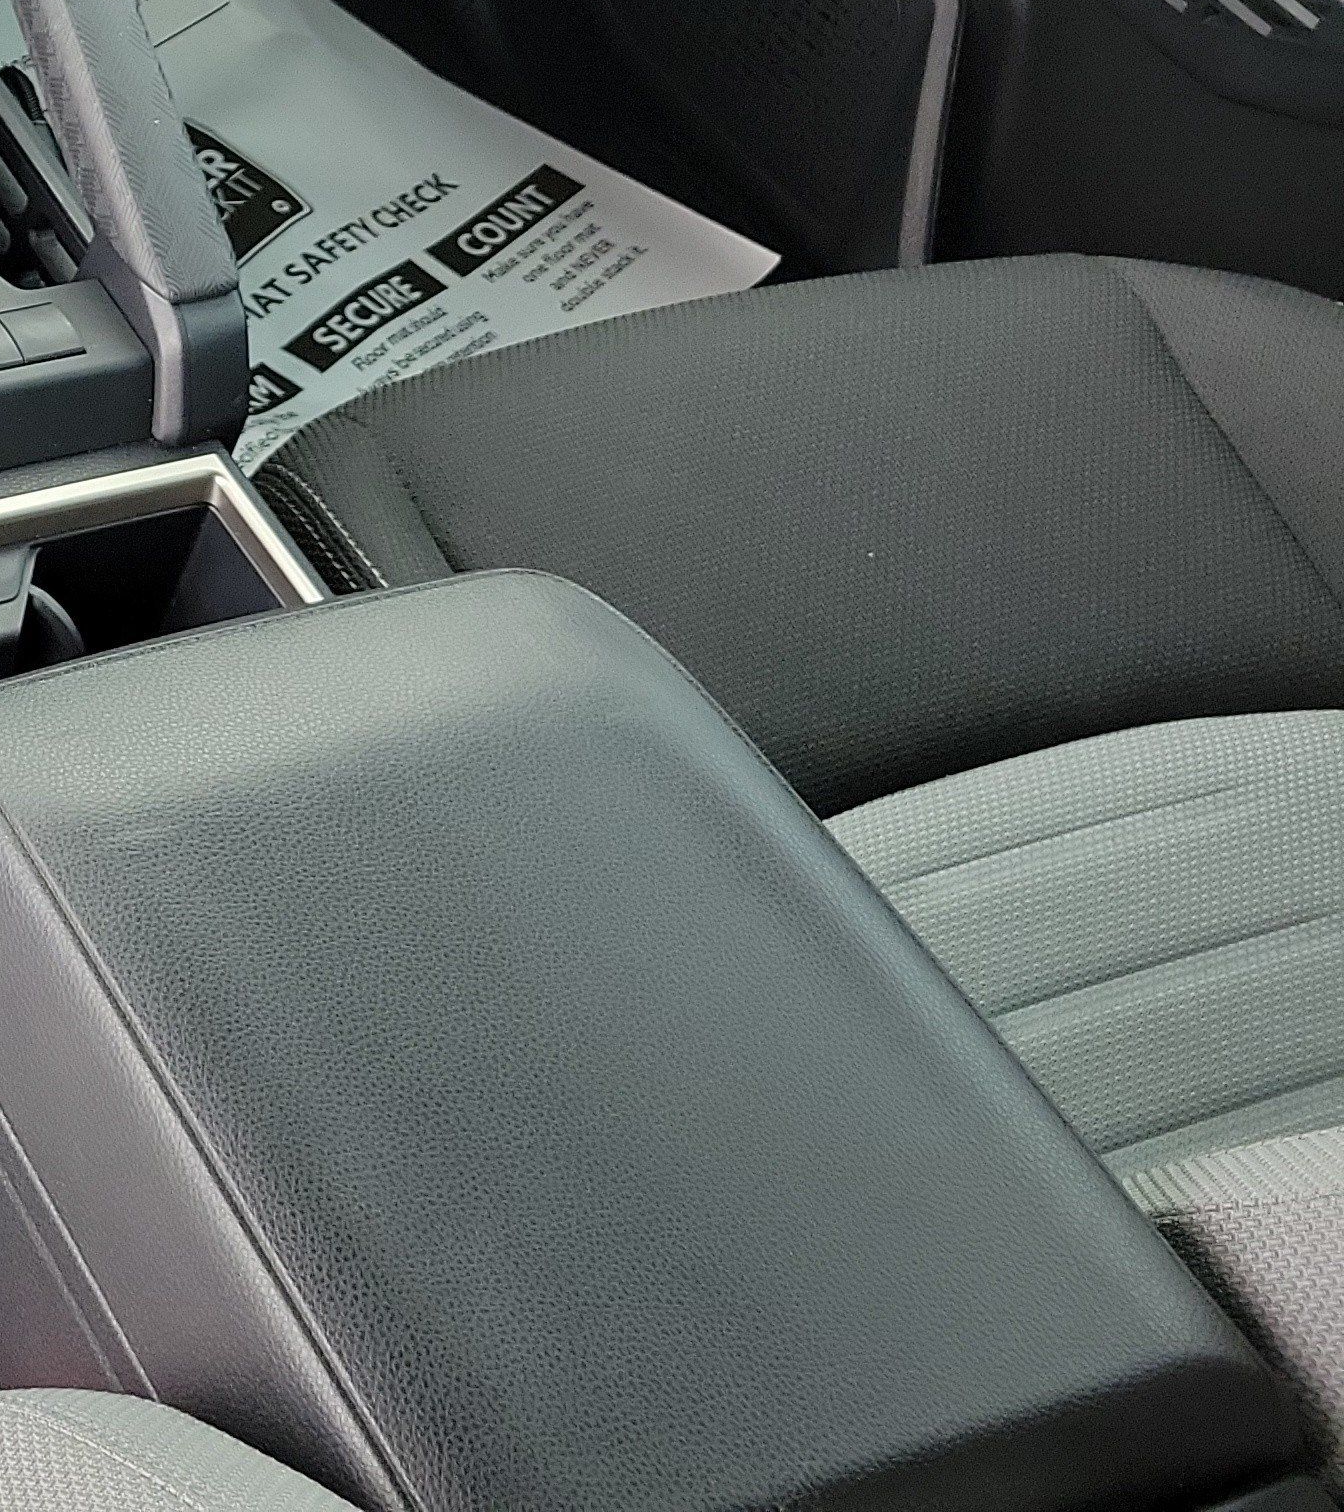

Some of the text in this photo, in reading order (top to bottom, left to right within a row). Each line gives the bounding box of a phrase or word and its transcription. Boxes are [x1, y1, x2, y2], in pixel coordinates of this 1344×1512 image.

[282, 216, 380, 285] SAFETY
[370, 172, 461, 228] CHECK
[457, 183, 556, 257] COUNT
[312, 274, 423, 354] SECURE
